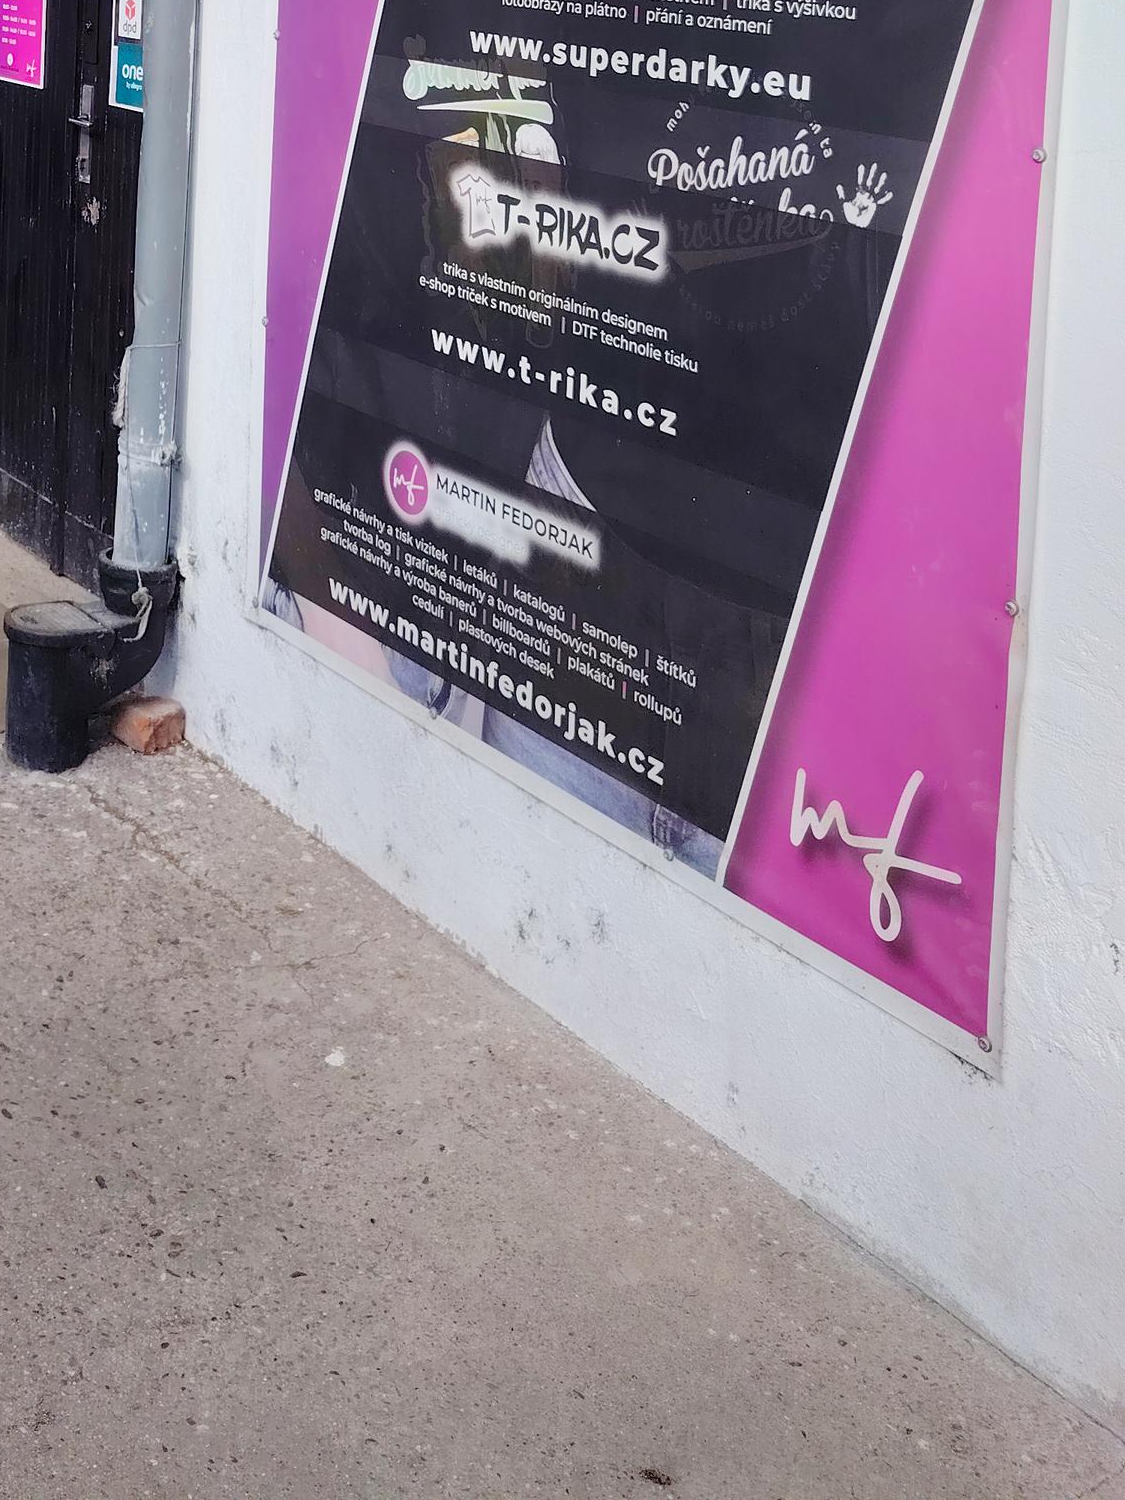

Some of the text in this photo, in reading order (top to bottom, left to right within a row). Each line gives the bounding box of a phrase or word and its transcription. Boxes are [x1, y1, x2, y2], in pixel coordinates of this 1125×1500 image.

[122, 21, 137, 35] dpd
[566, 1, 582, 14] na
[585, 1, 627, 19] plátno
[645, 7, 683, 26] přání
[685, 14, 694, 26] a
[696, 16, 773, 35] oznámení
[774, 0, 783, 13] s
[121, 64, 144, 82] one
[469, 30, 812, 101] www.superdarky.eu
[647, 128, 816, 192] Pošahaná
[497, 194, 661, 271] T-RIKA.CZ
[419, 275, 699, 374] e-shop triček s motivem DTF technolie tisku
[442, 261, 669, 341] trika s vlastním originálním designem
[431, 328, 677, 437] www.t-rika.cz
[436, 473, 496, 516] MARTIN
[501, 502, 594, 561] FEDORJAK
[313, 488, 697, 688] grafické návrhy a tisk vizitek letáků katalogů samolep štítků
[320, 527, 683, 726] grafické návrhy a výroba banerů billboardů plakátů rollupů
[343, 519, 650, 687] tvorba log grafické návrhy a tvorba webových stránek
[412, 594, 555, 680] cedulí plastových desek
[328, 577, 665, 786] www.martinfedorjak.cz
